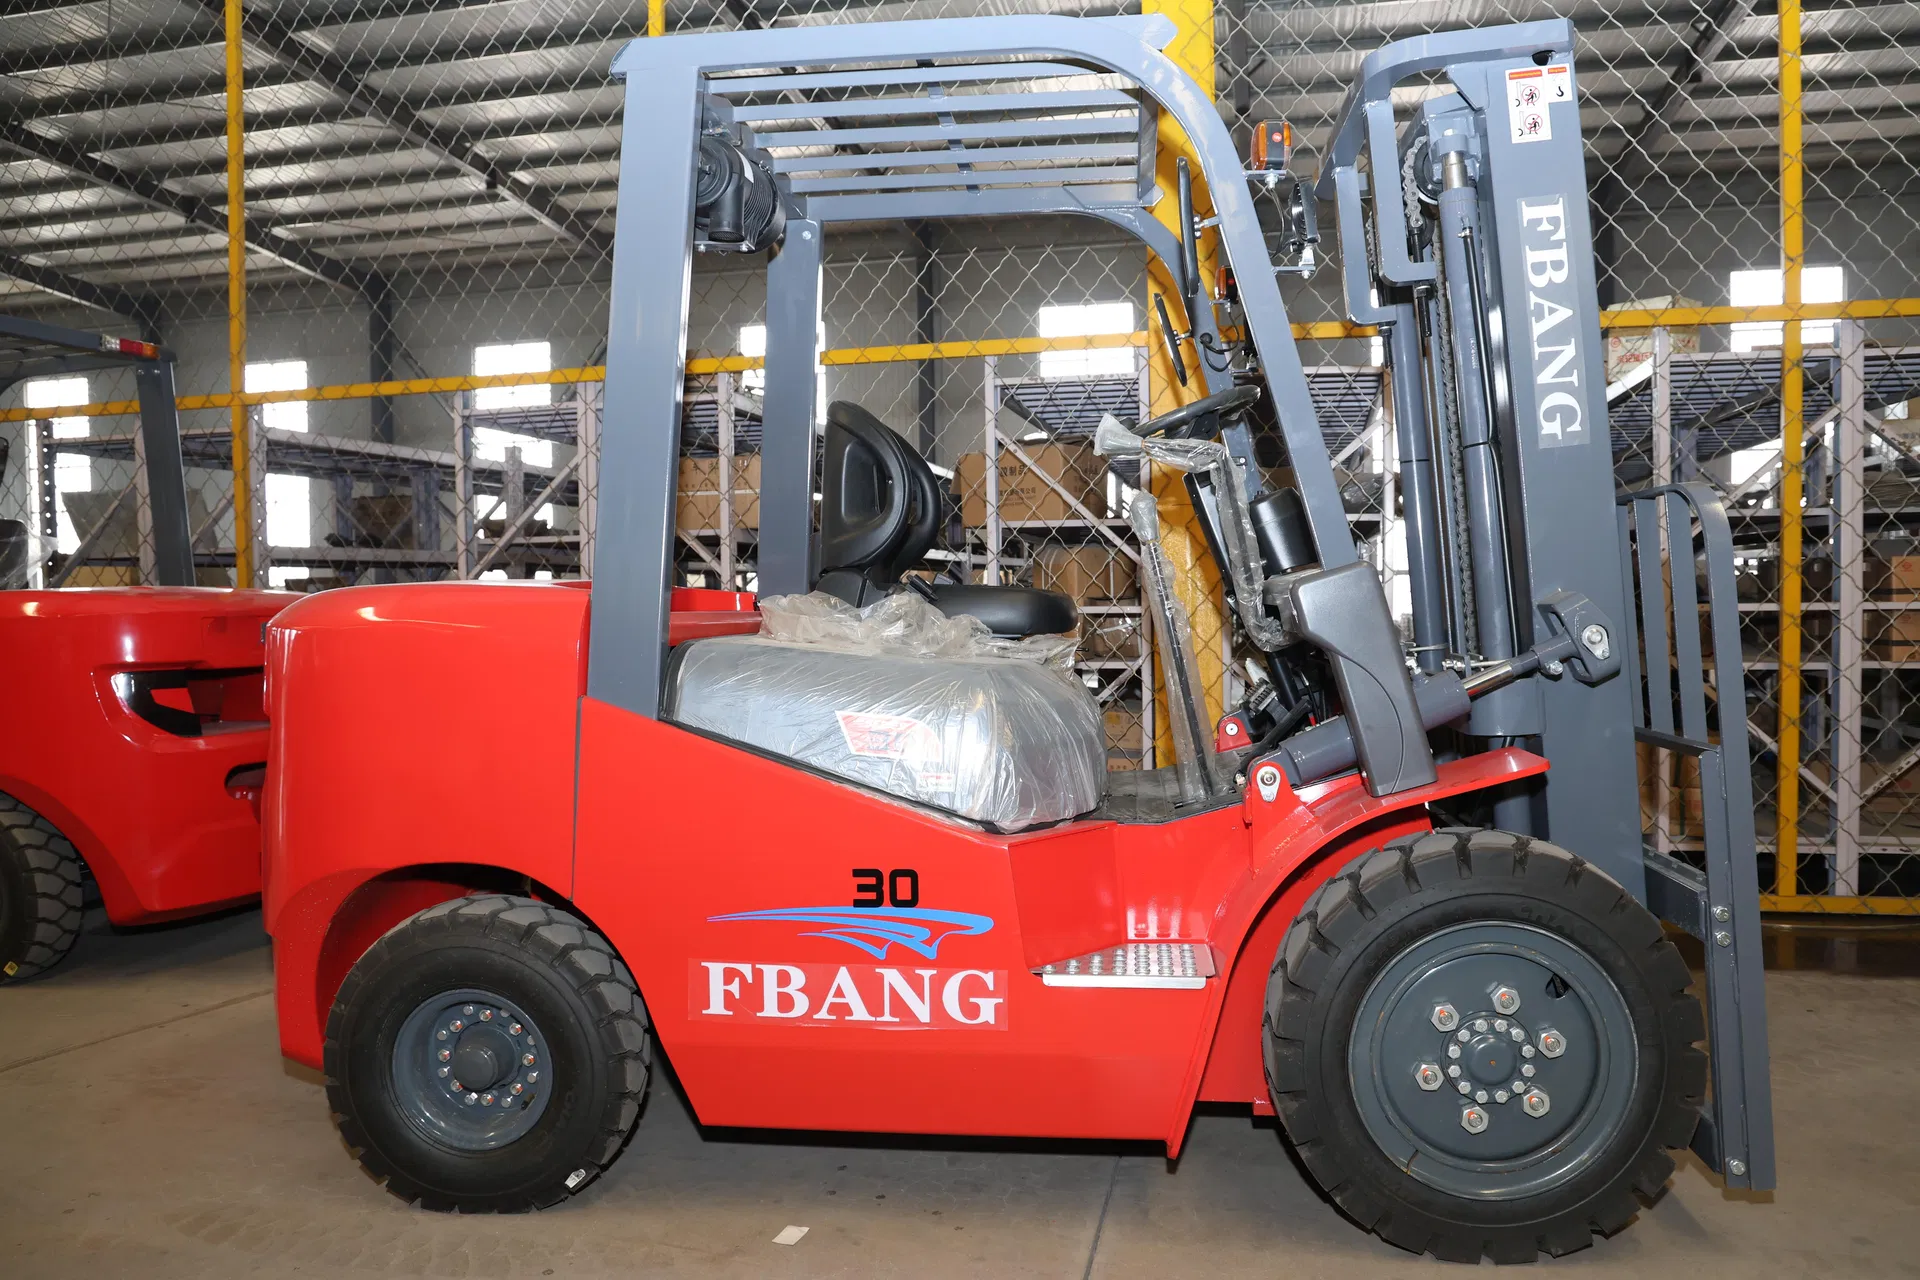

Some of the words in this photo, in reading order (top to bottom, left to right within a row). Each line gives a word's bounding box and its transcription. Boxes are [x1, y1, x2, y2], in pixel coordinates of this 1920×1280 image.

[1521, 197, 1582, 440] FBANG
[852, 868, 919, 908] 30
[701, 961, 1004, 1024] FBANG
